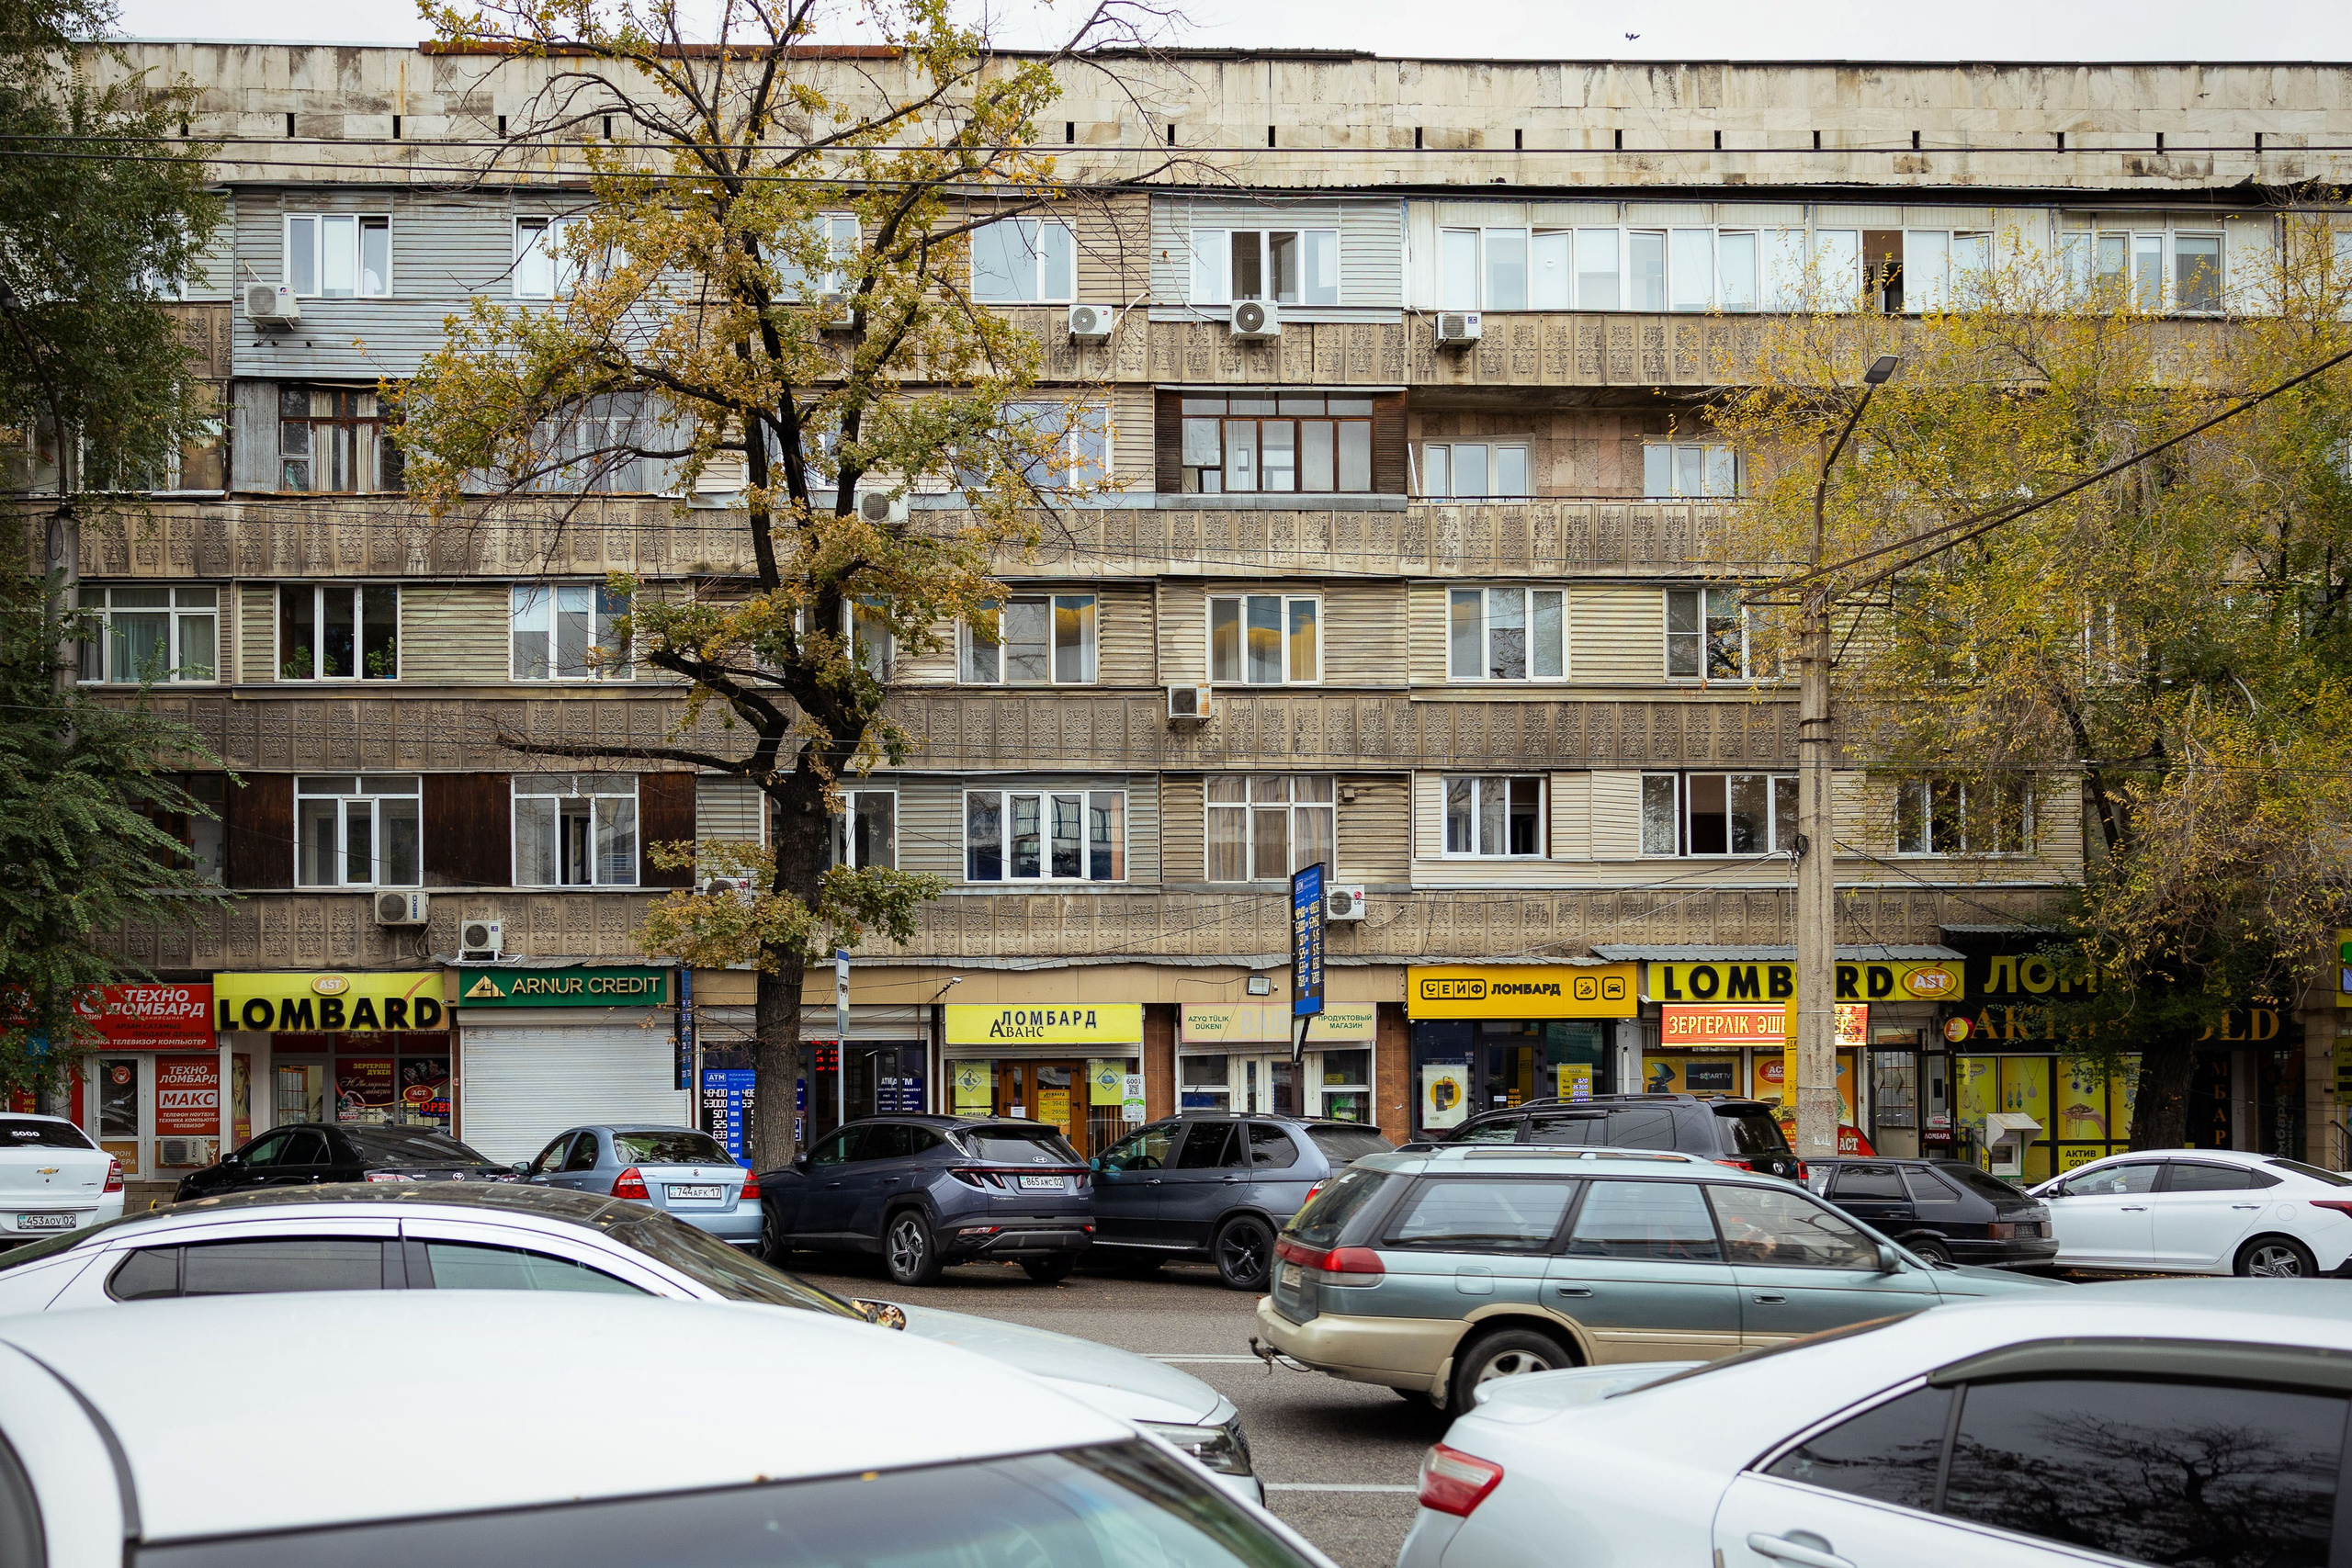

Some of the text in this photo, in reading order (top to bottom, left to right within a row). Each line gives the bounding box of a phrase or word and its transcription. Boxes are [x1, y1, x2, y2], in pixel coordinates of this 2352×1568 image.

[318, 979, 341, 989] AST
[511, 976, 661, 994] ARNUR CREDIT
[1425, 980, 1483, 996] СЕЙФ
[1663, 964, 1894, 999] LOMBRD
[1913, 974, 1948, 989] AST
[125, 989, 189, 1002] ТЕХНО
[1490, 983, 1562, 997] ЛОМБАРД
[106, 1002, 206, 1018] ЛОМБАРД
[219, 997, 442, 1030] LOMBARD
[1001, 1010, 1097, 1029] ЛОМБАРД
[1318, 1014, 1373, 1022] ПРОДУКТОВЫЙ
[169, 1066, 208, 1075] ТЕХНО
[159, 1074, 218, 1084] ЛОМБАРД
[162, 1092, 216, 1106] МАКС
[1838, 1137, 1859, 1151] АСТ
[1054, 1178, 1063, 1186] 02
[63, 1215, 74, 1224] 02
